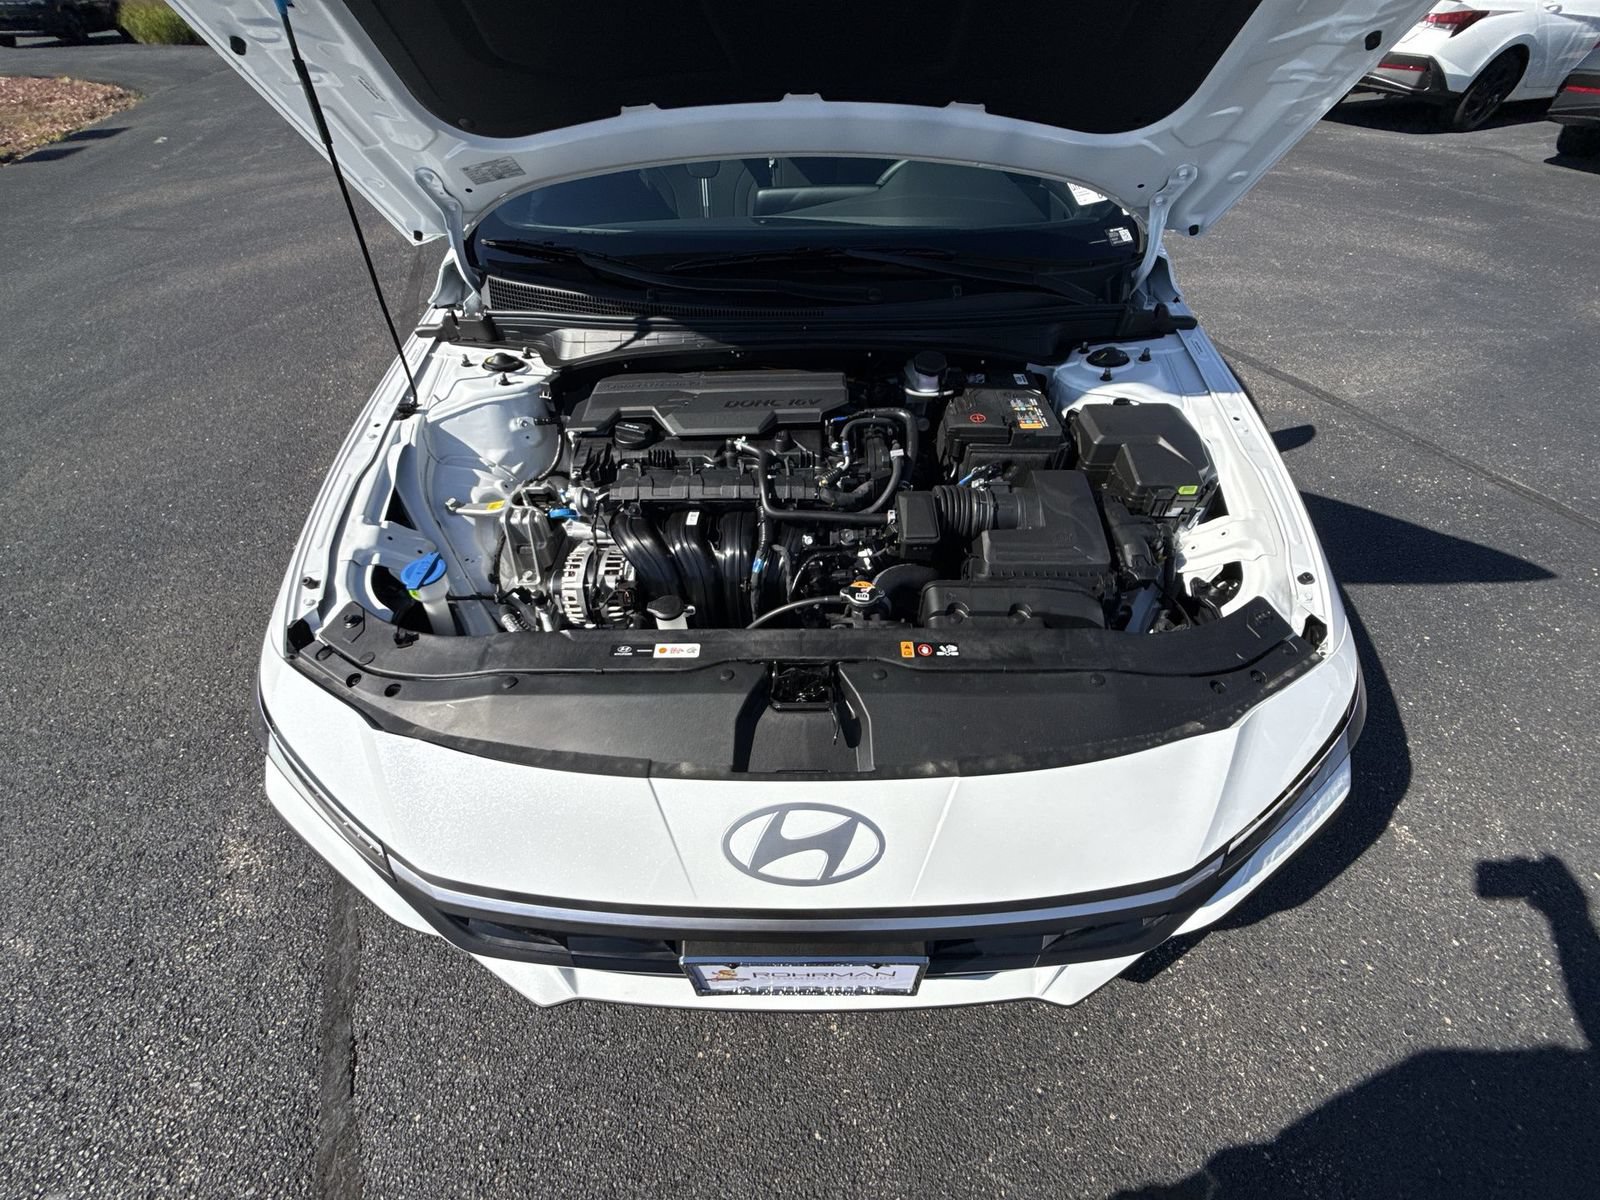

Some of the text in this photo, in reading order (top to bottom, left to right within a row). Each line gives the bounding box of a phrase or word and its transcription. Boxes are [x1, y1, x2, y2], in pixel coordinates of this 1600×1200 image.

[723, 398, 824, 409] DOHC 16V
[752, 970, 897, 978] ROHRMAN
